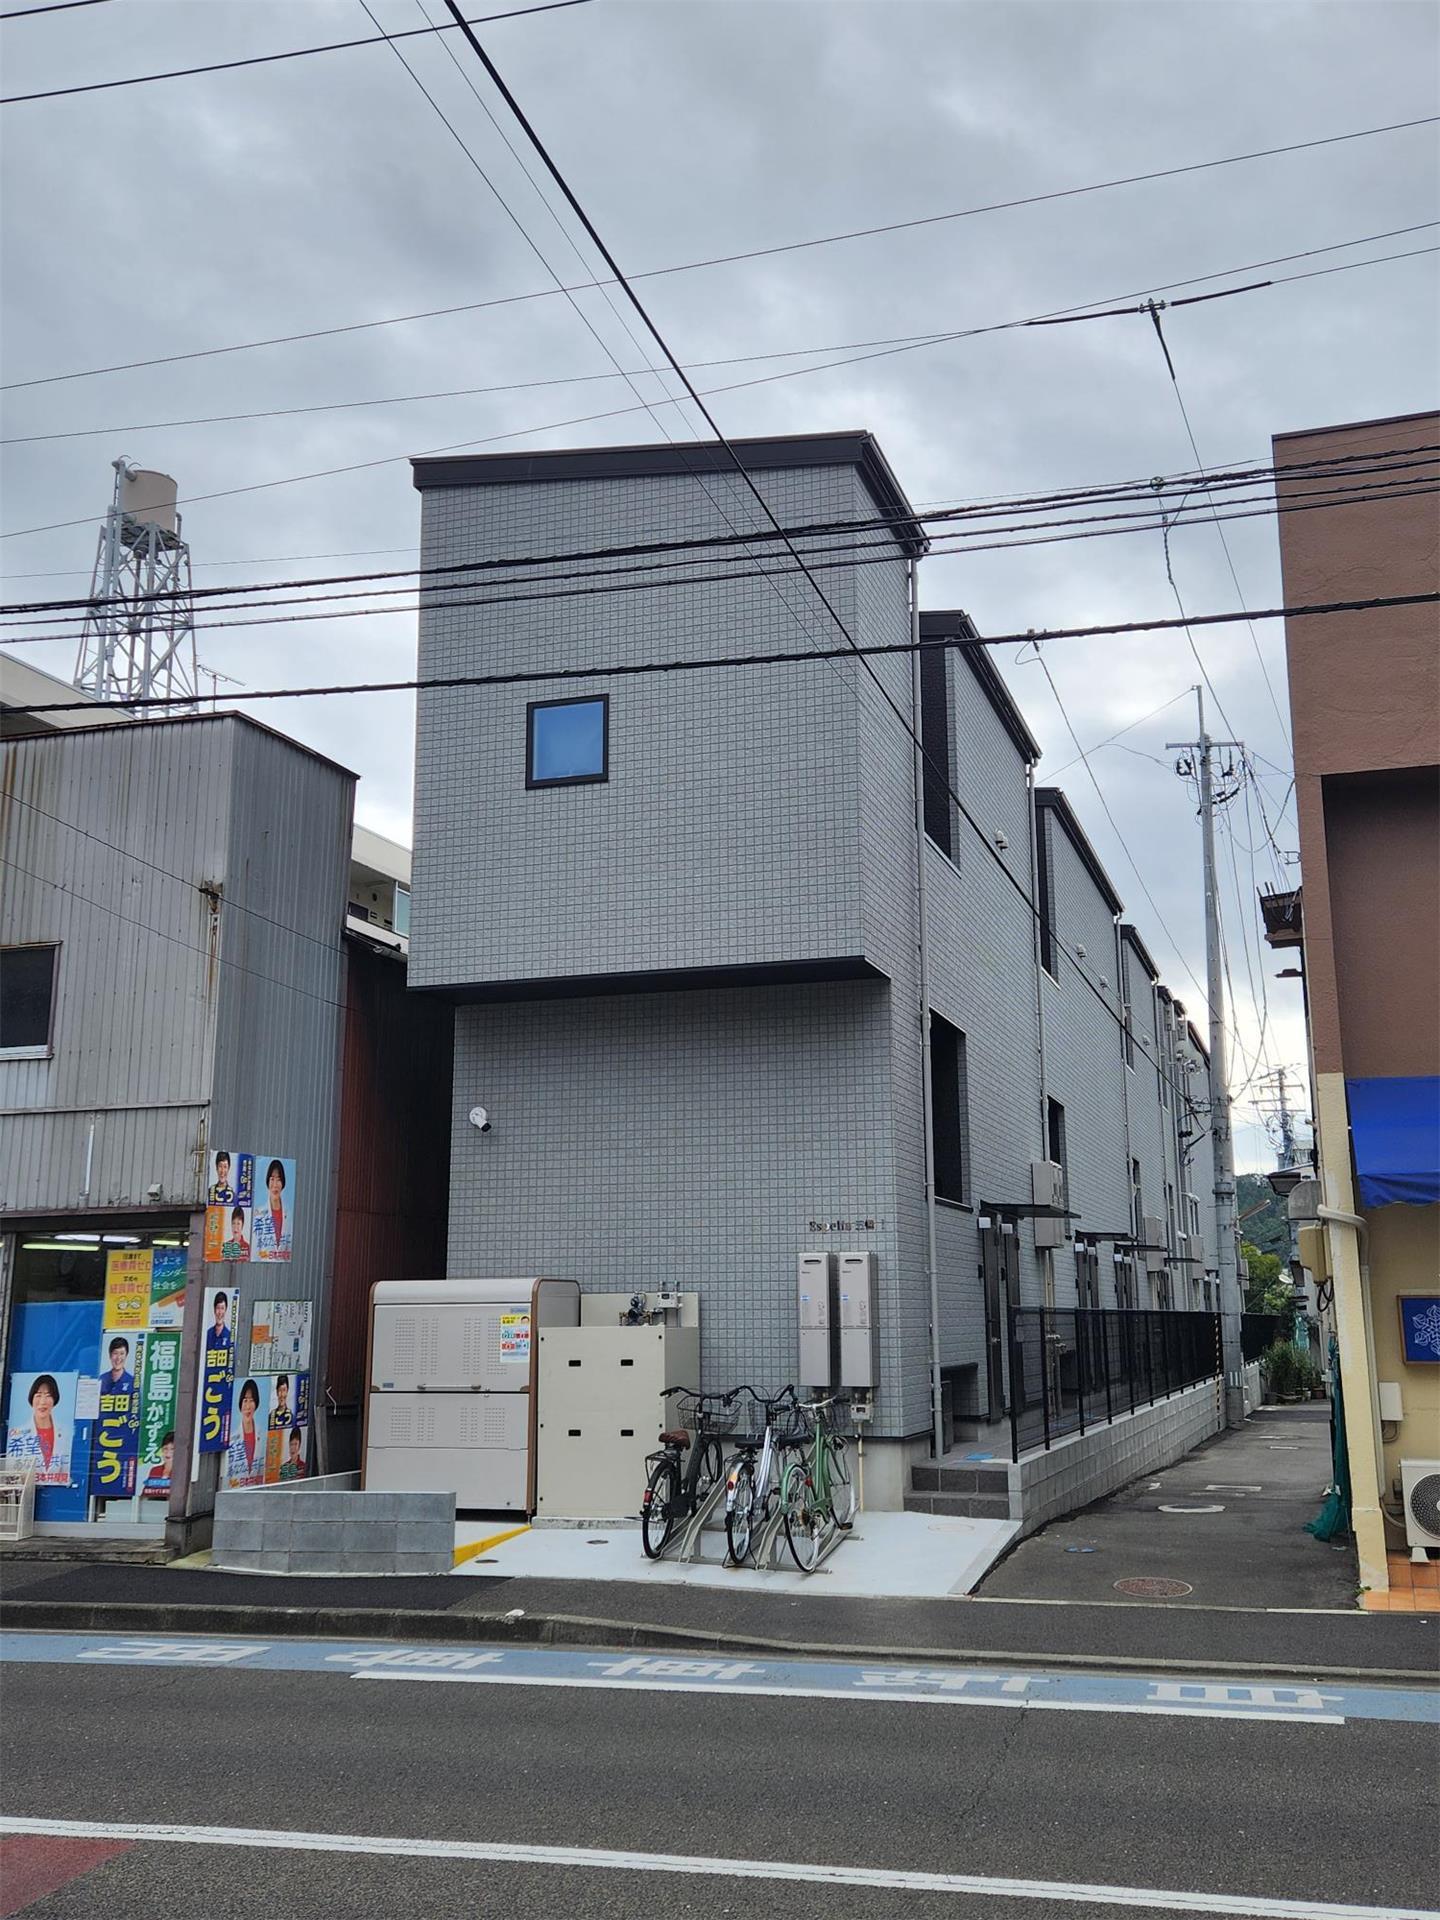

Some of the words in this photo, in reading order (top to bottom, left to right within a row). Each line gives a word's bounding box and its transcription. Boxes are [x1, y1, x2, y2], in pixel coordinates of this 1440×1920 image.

[97, 1393, 129, 1484] 吉田ごう
[144, 1340, 177, 1464] 福島かずえ
